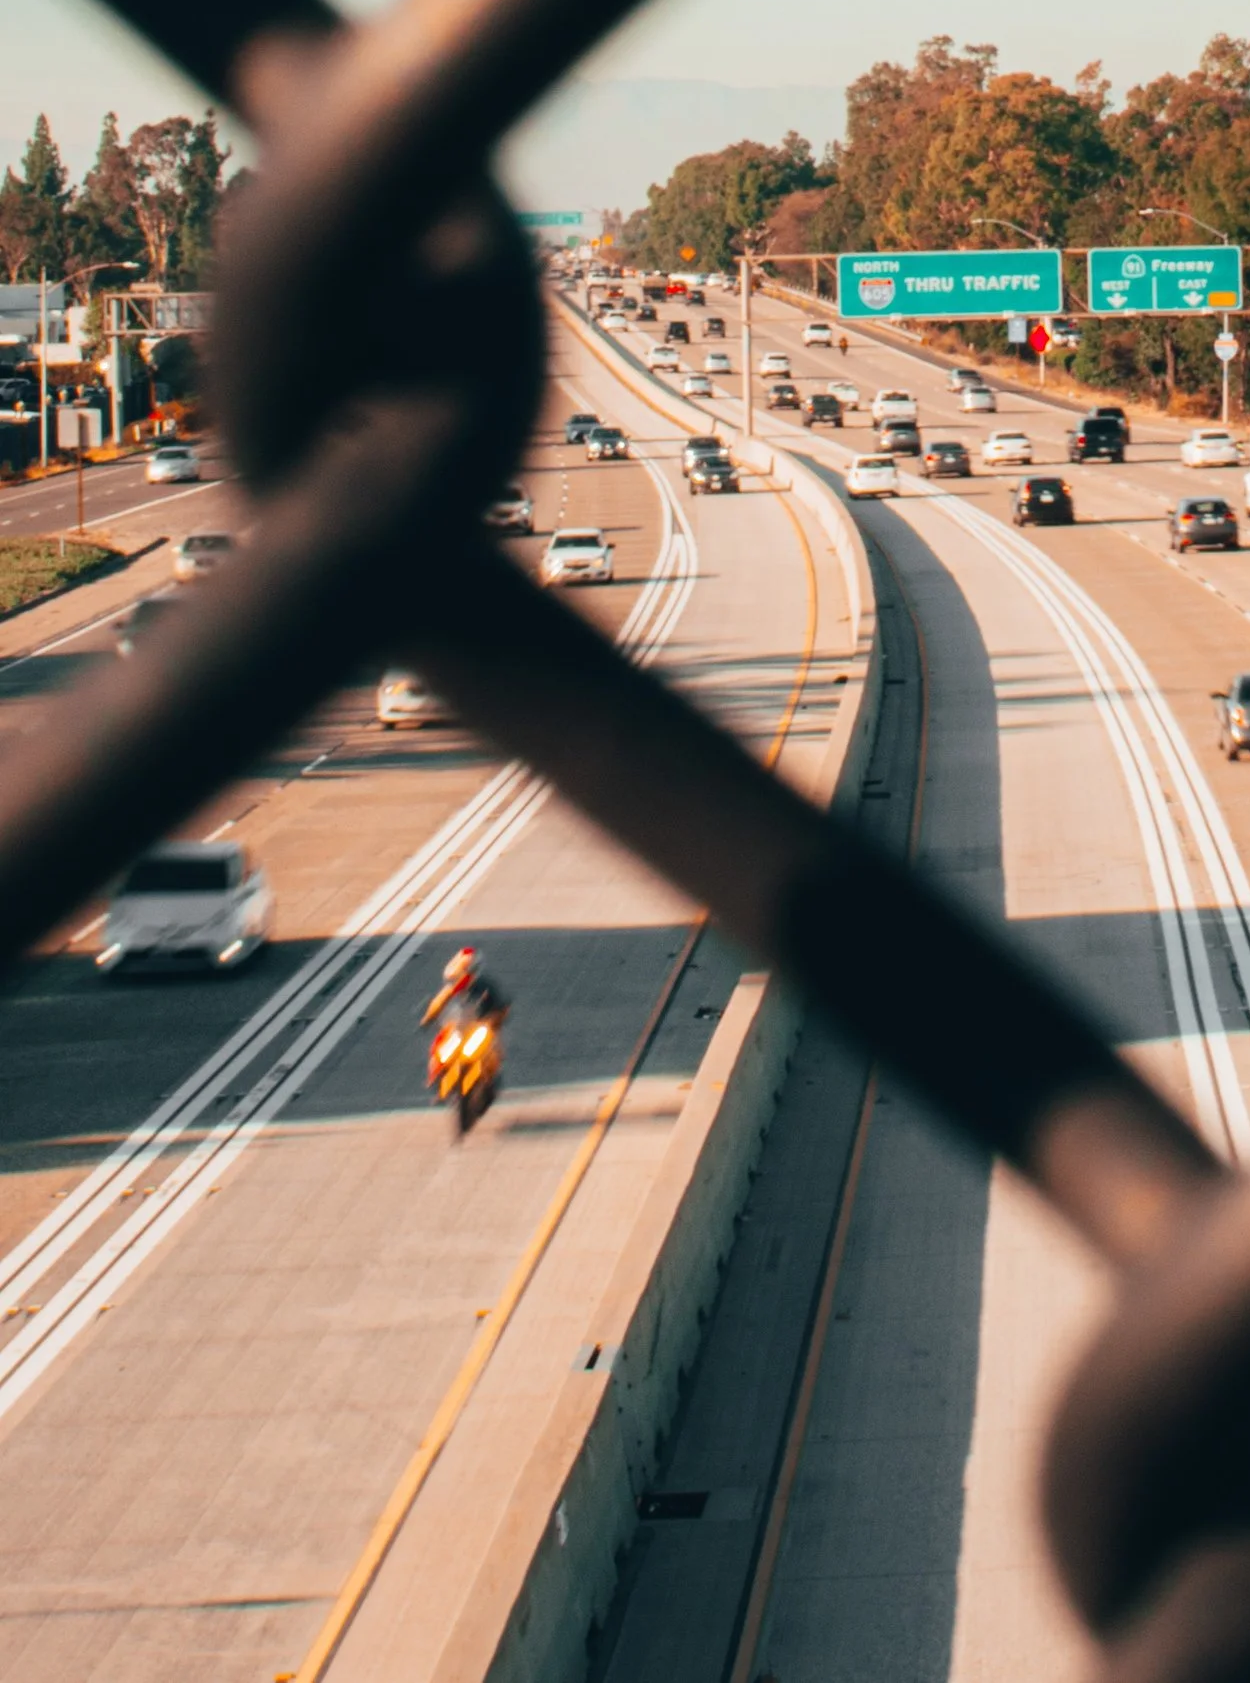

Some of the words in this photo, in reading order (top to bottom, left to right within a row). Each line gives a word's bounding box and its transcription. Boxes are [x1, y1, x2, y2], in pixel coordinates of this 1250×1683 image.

[853, 261, 900, 274] NORTH
[1126, 261, 1141, 273] 91
[1151, 259, 1214, 274] Freeway
[904, 276, 954, 293] THRU
[962, 274, 1040, 291] TRAFFIC
[1101, 280, 1130, 292] WEST
[1178, 278, 1208, 290] EAST
